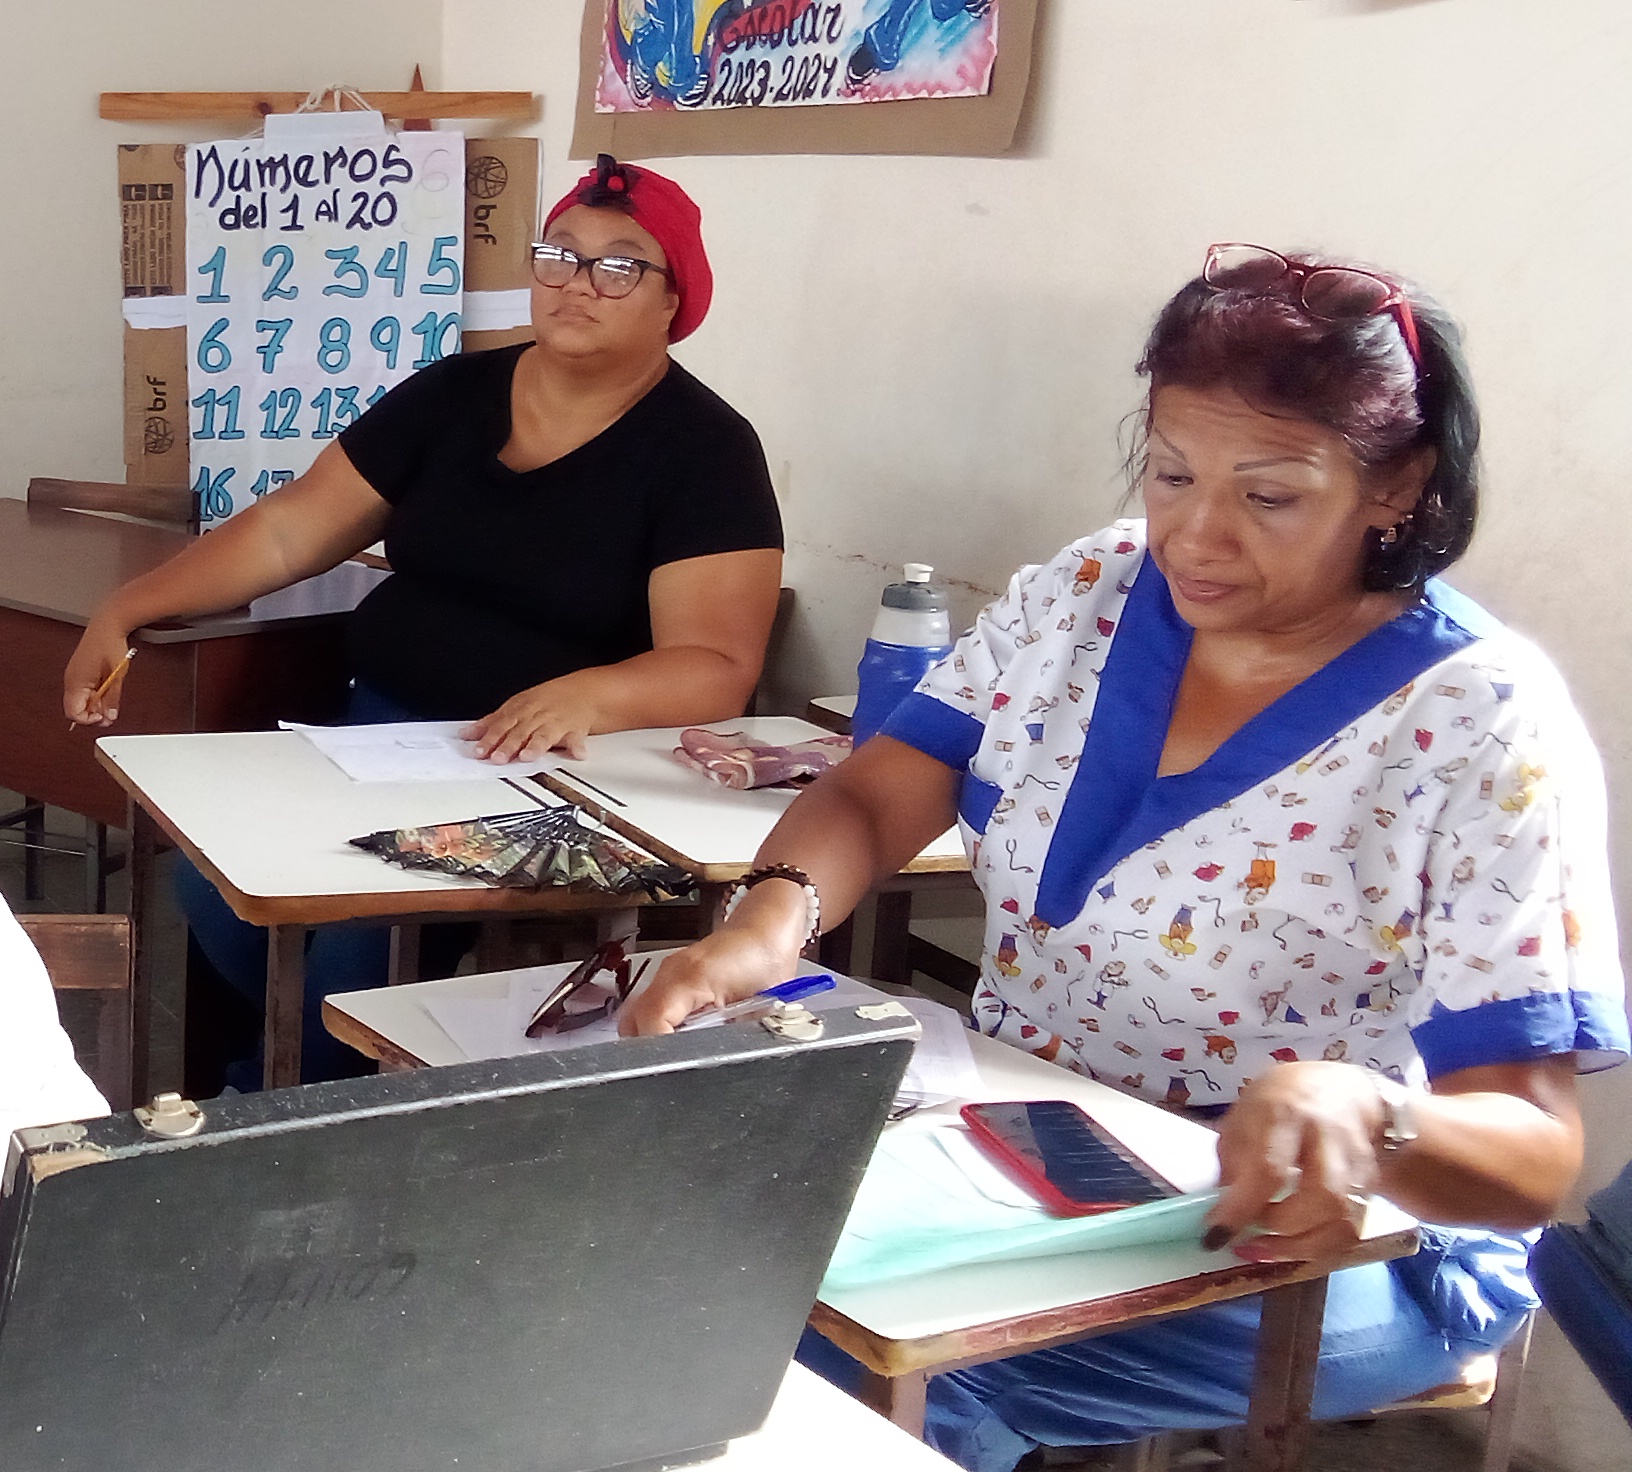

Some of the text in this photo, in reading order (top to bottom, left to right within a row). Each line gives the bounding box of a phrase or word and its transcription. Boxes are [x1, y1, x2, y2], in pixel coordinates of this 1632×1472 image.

[194, 143, 414, 207] Números
[219, 196, 267, 231] del
[279, 195, 305, 231] 1
[345, 191, 398, 231] 20
[473, 204, 498, 246] brf
[196, 235, 461, 304] 1 2 3 4 5
[197, 311, 461, 374] 6 7 8 9 10
[146, 375, 167, 412] brf
[192, 385, 245, 440] 11
[258, 387, 301, 439] 12
[311, 385, 362, 439] 13
[193, 466, 236, 522] 16
